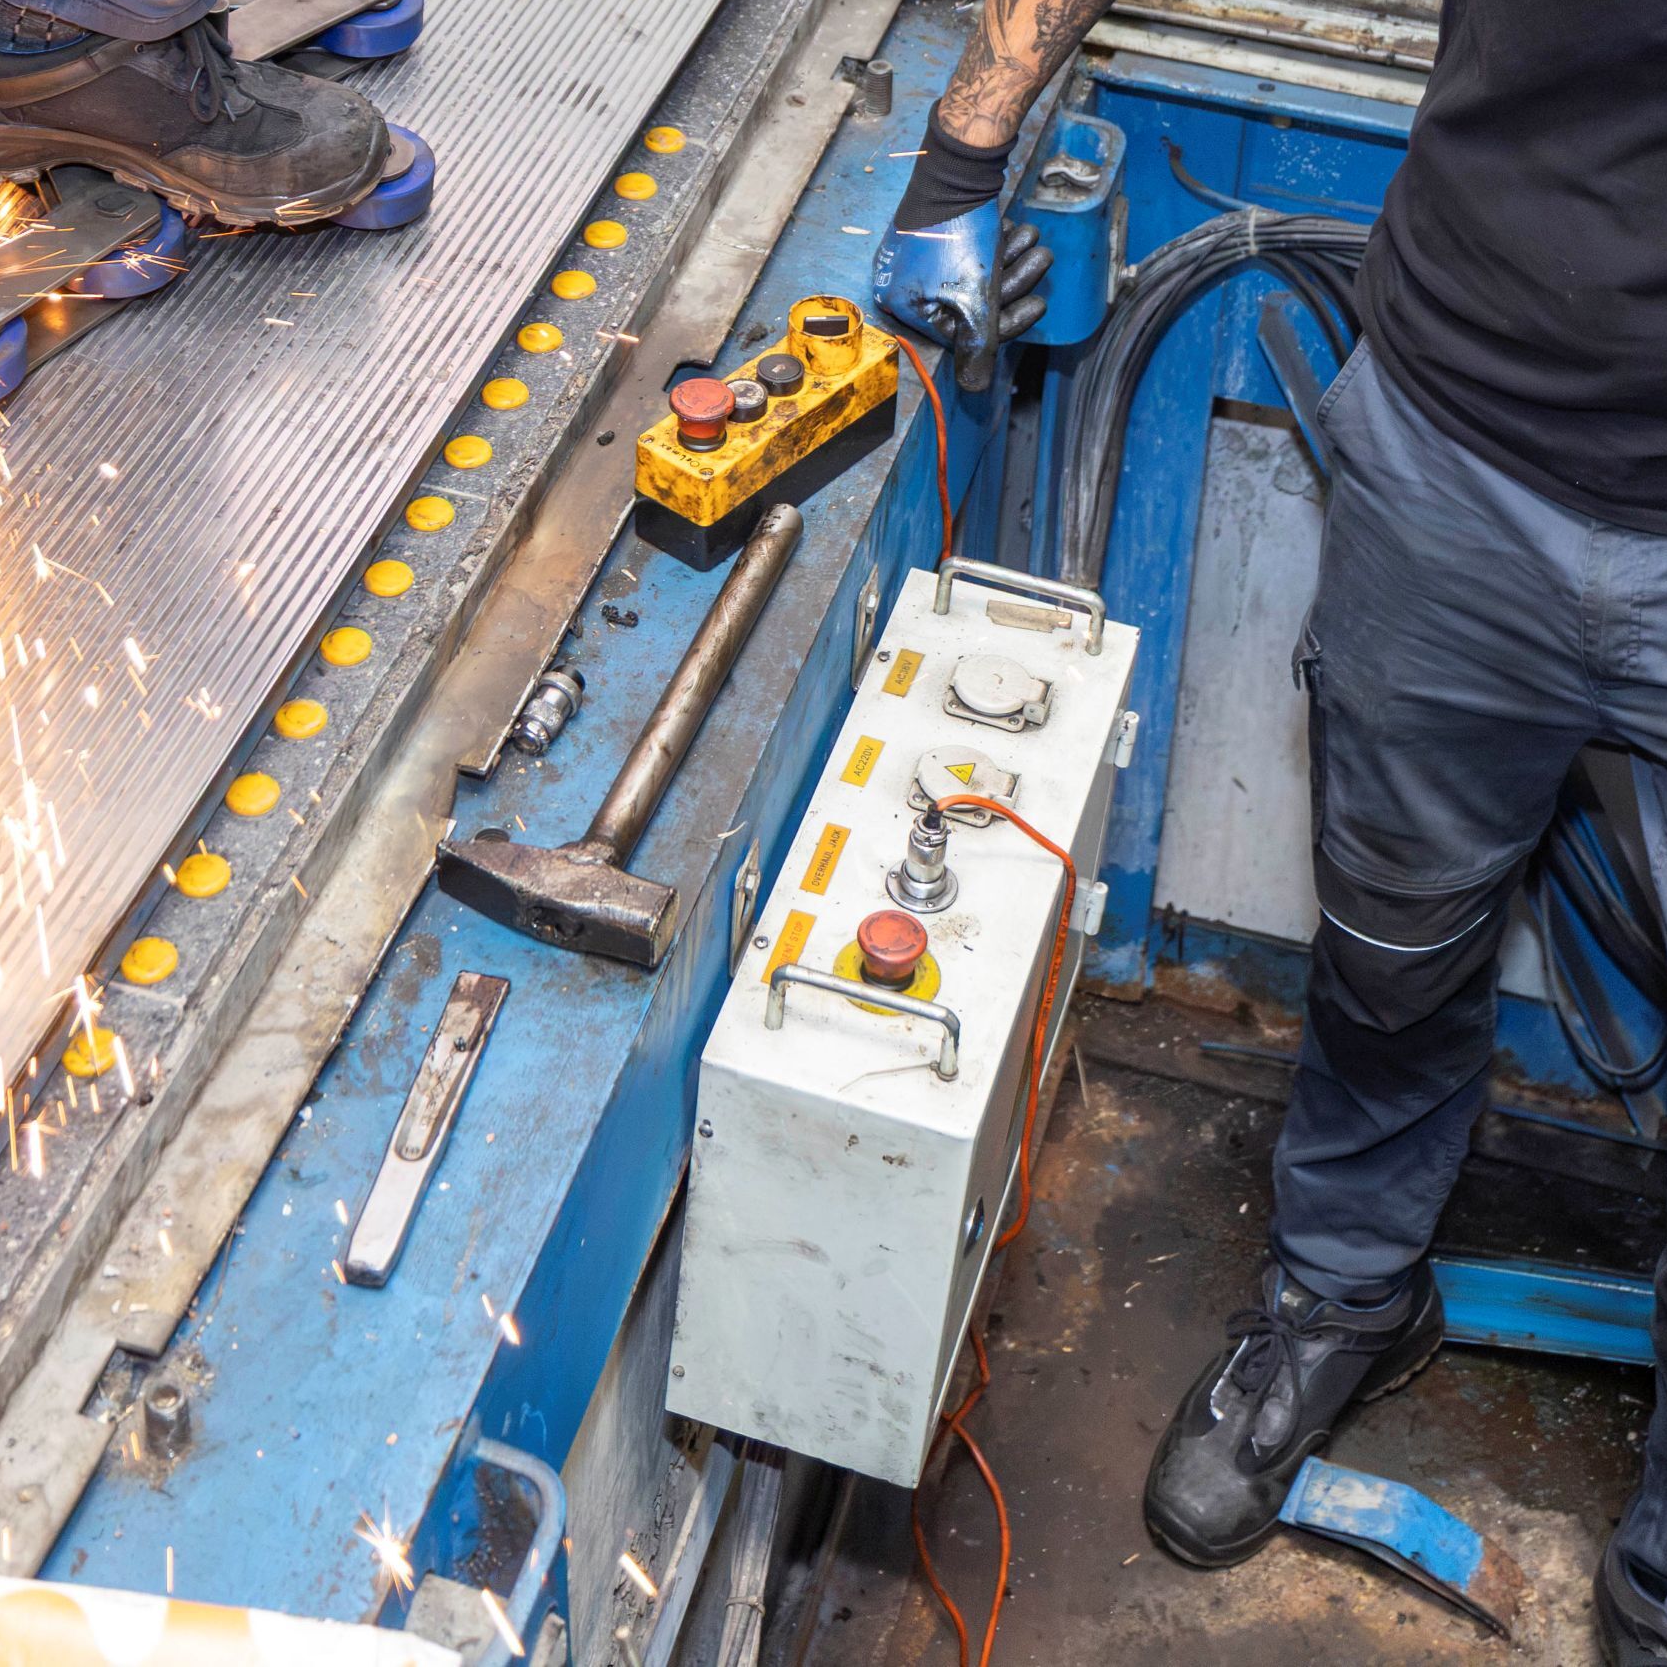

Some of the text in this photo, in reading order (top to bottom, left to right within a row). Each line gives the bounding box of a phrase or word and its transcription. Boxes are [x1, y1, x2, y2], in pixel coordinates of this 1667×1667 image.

[853, 744, 874, 777] AC220V
[811, 829, 841, 886] OVERHAUL JACK
